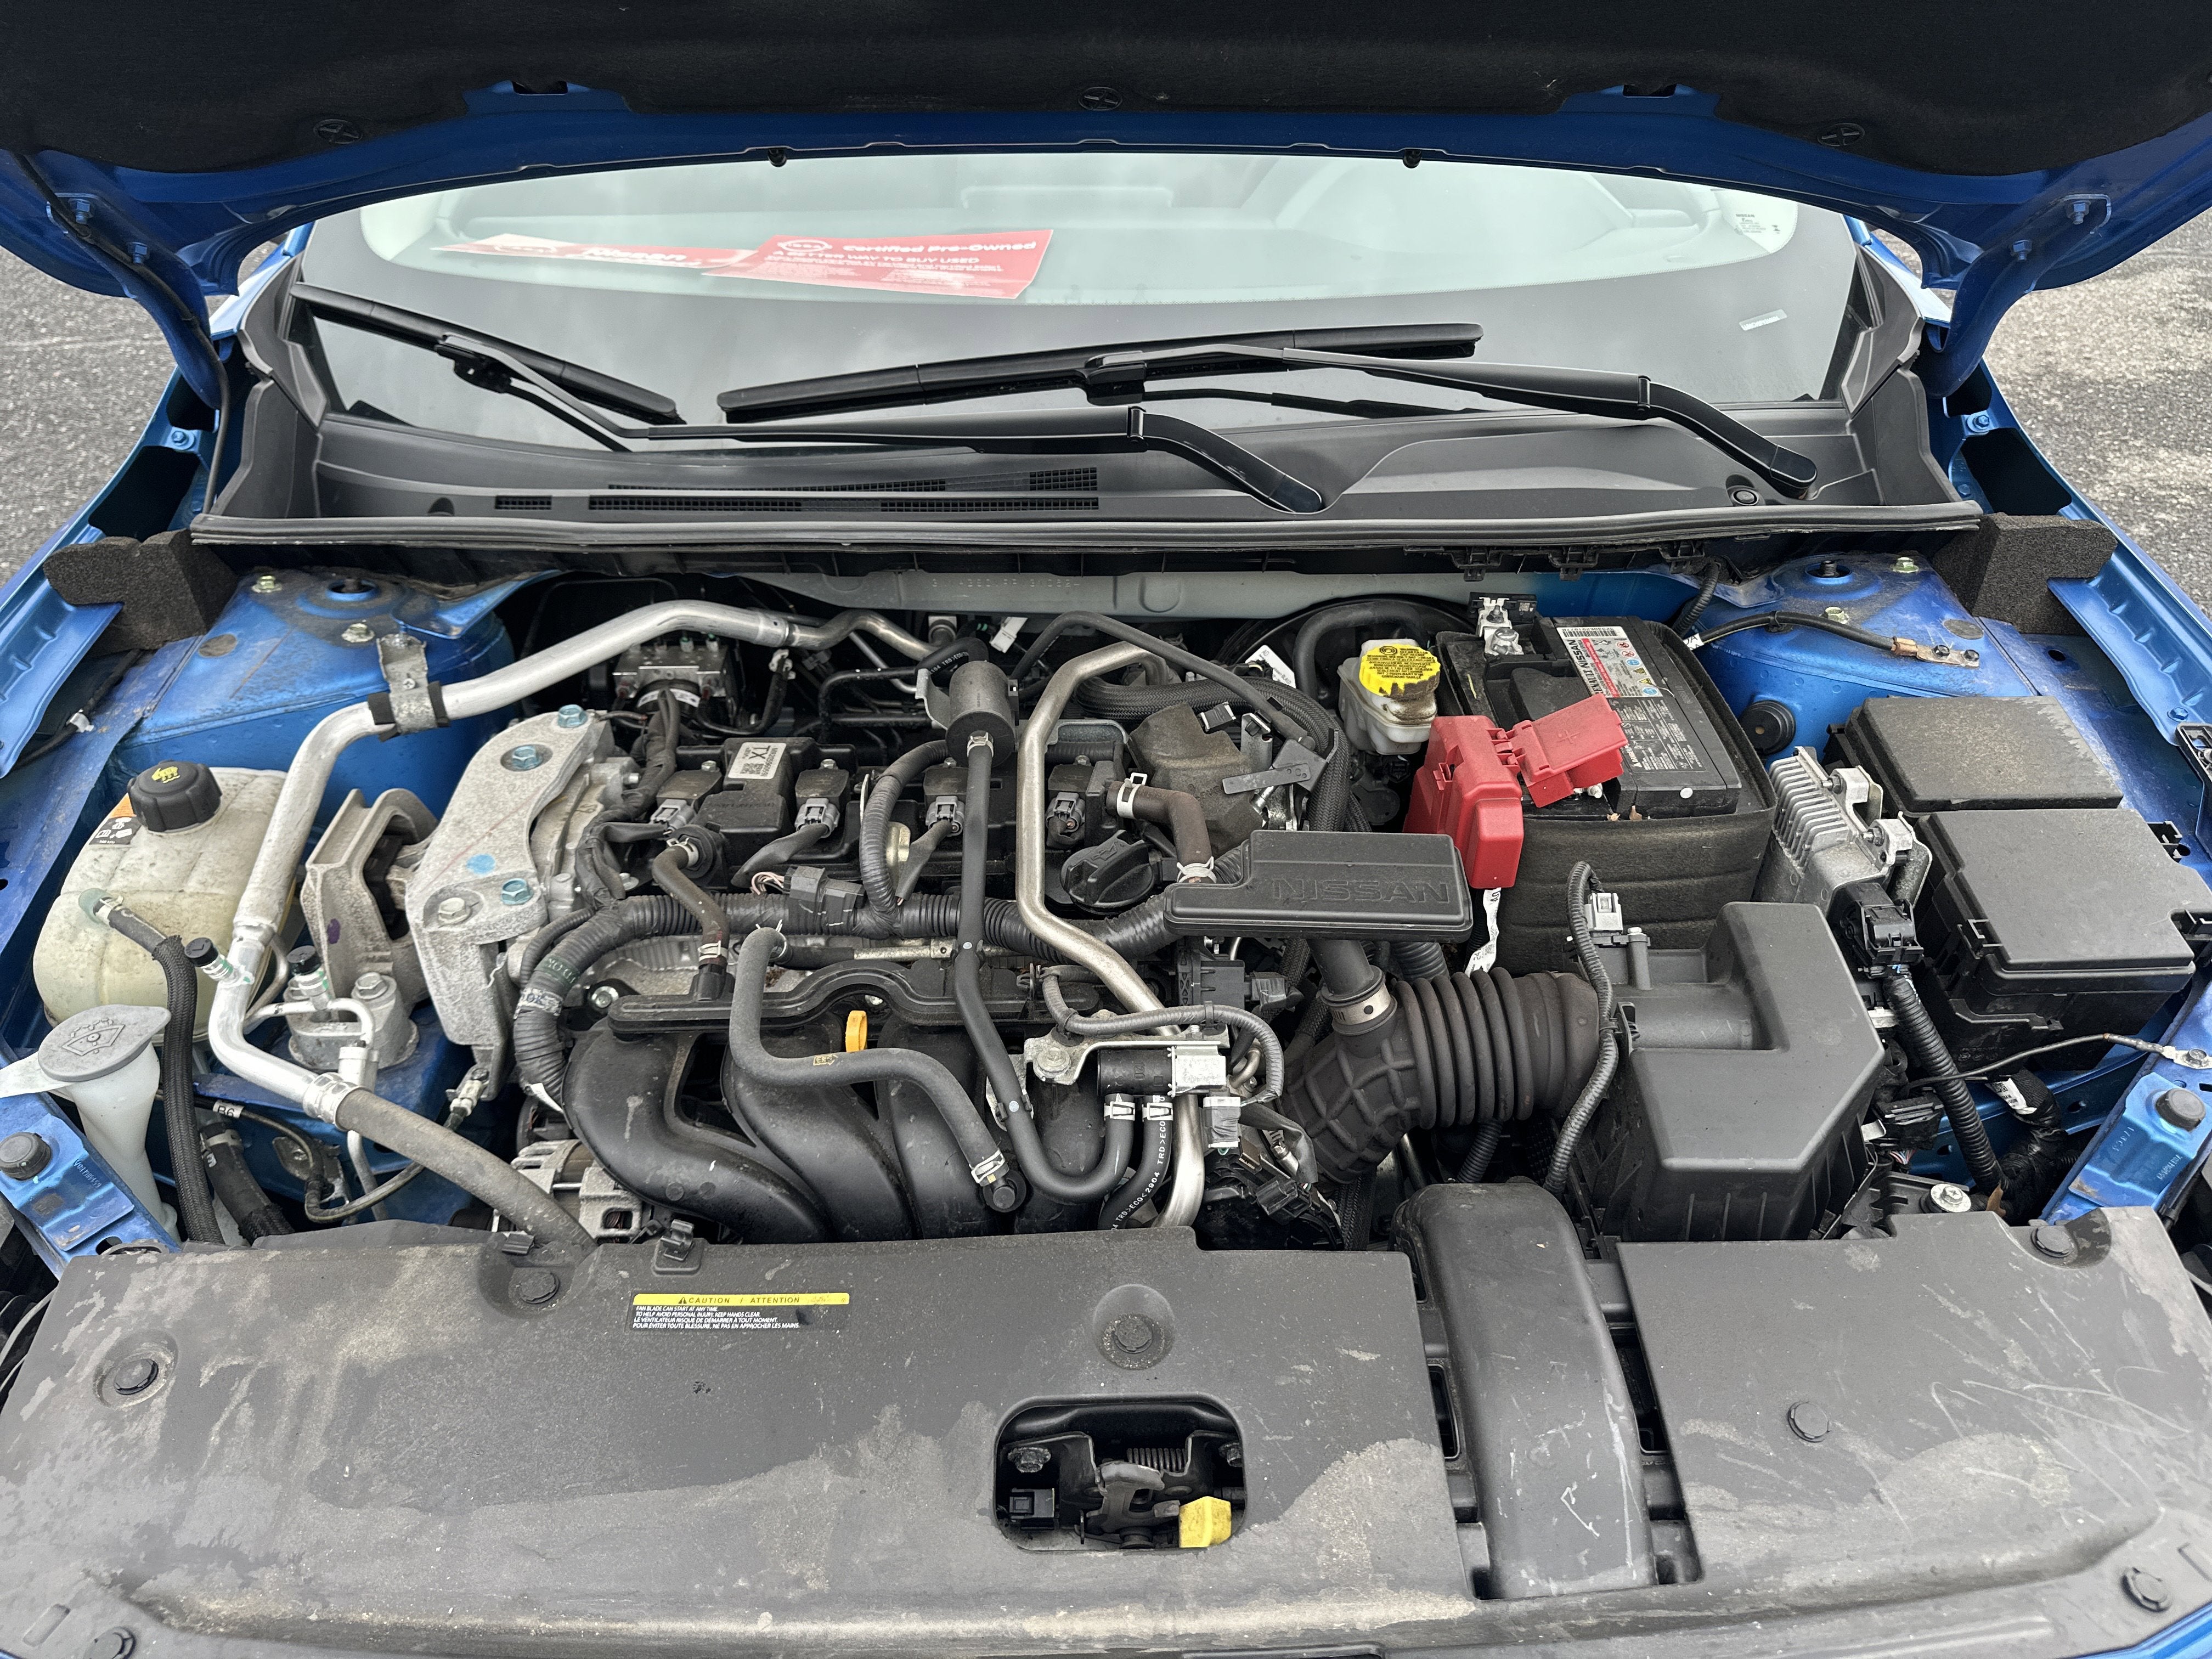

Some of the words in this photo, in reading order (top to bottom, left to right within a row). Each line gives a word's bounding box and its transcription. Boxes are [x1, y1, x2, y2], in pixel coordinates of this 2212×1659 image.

[928, 241, 1036, 252] Pre-Owned
[748, 746, 771, 759] TX
[1273, 878, 1450, 904] NISSAN
[217, 1105, 235, 1118] B6
